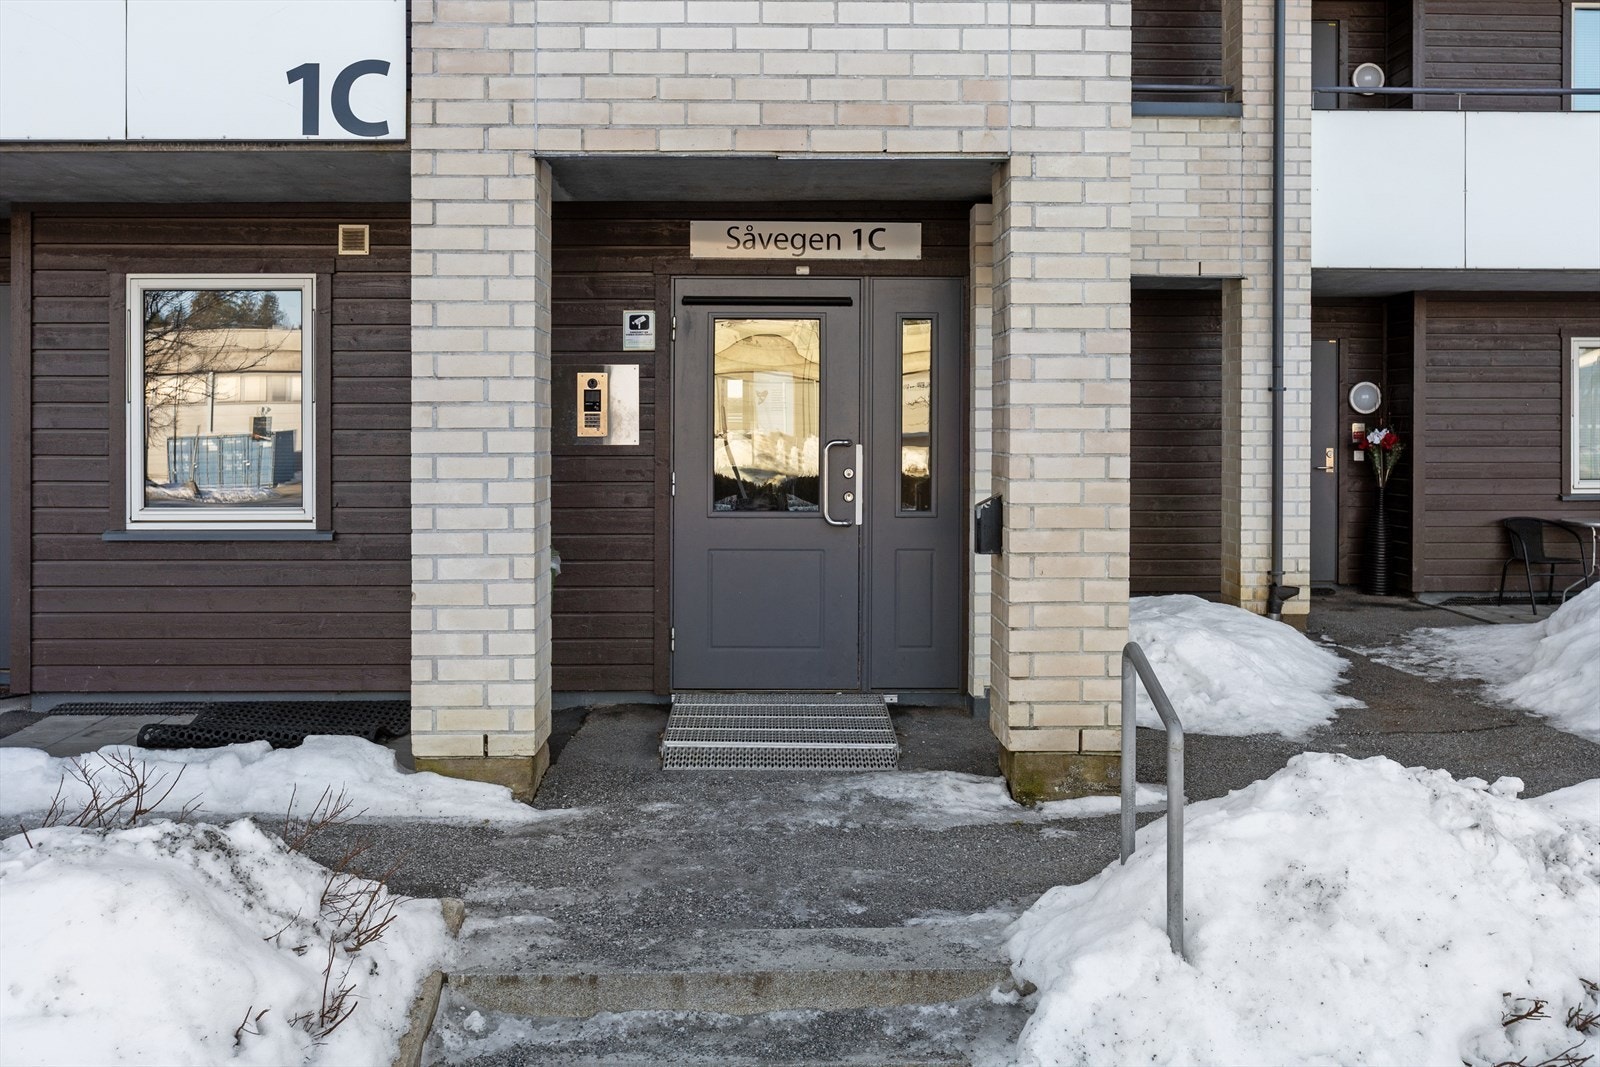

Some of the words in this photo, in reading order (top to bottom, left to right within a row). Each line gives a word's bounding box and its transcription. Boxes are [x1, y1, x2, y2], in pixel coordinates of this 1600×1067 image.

[286, 59, 391, 137] 1C
[726, 224, 841, 257] Såvegen
[852, 227, 886, 251] 1C
